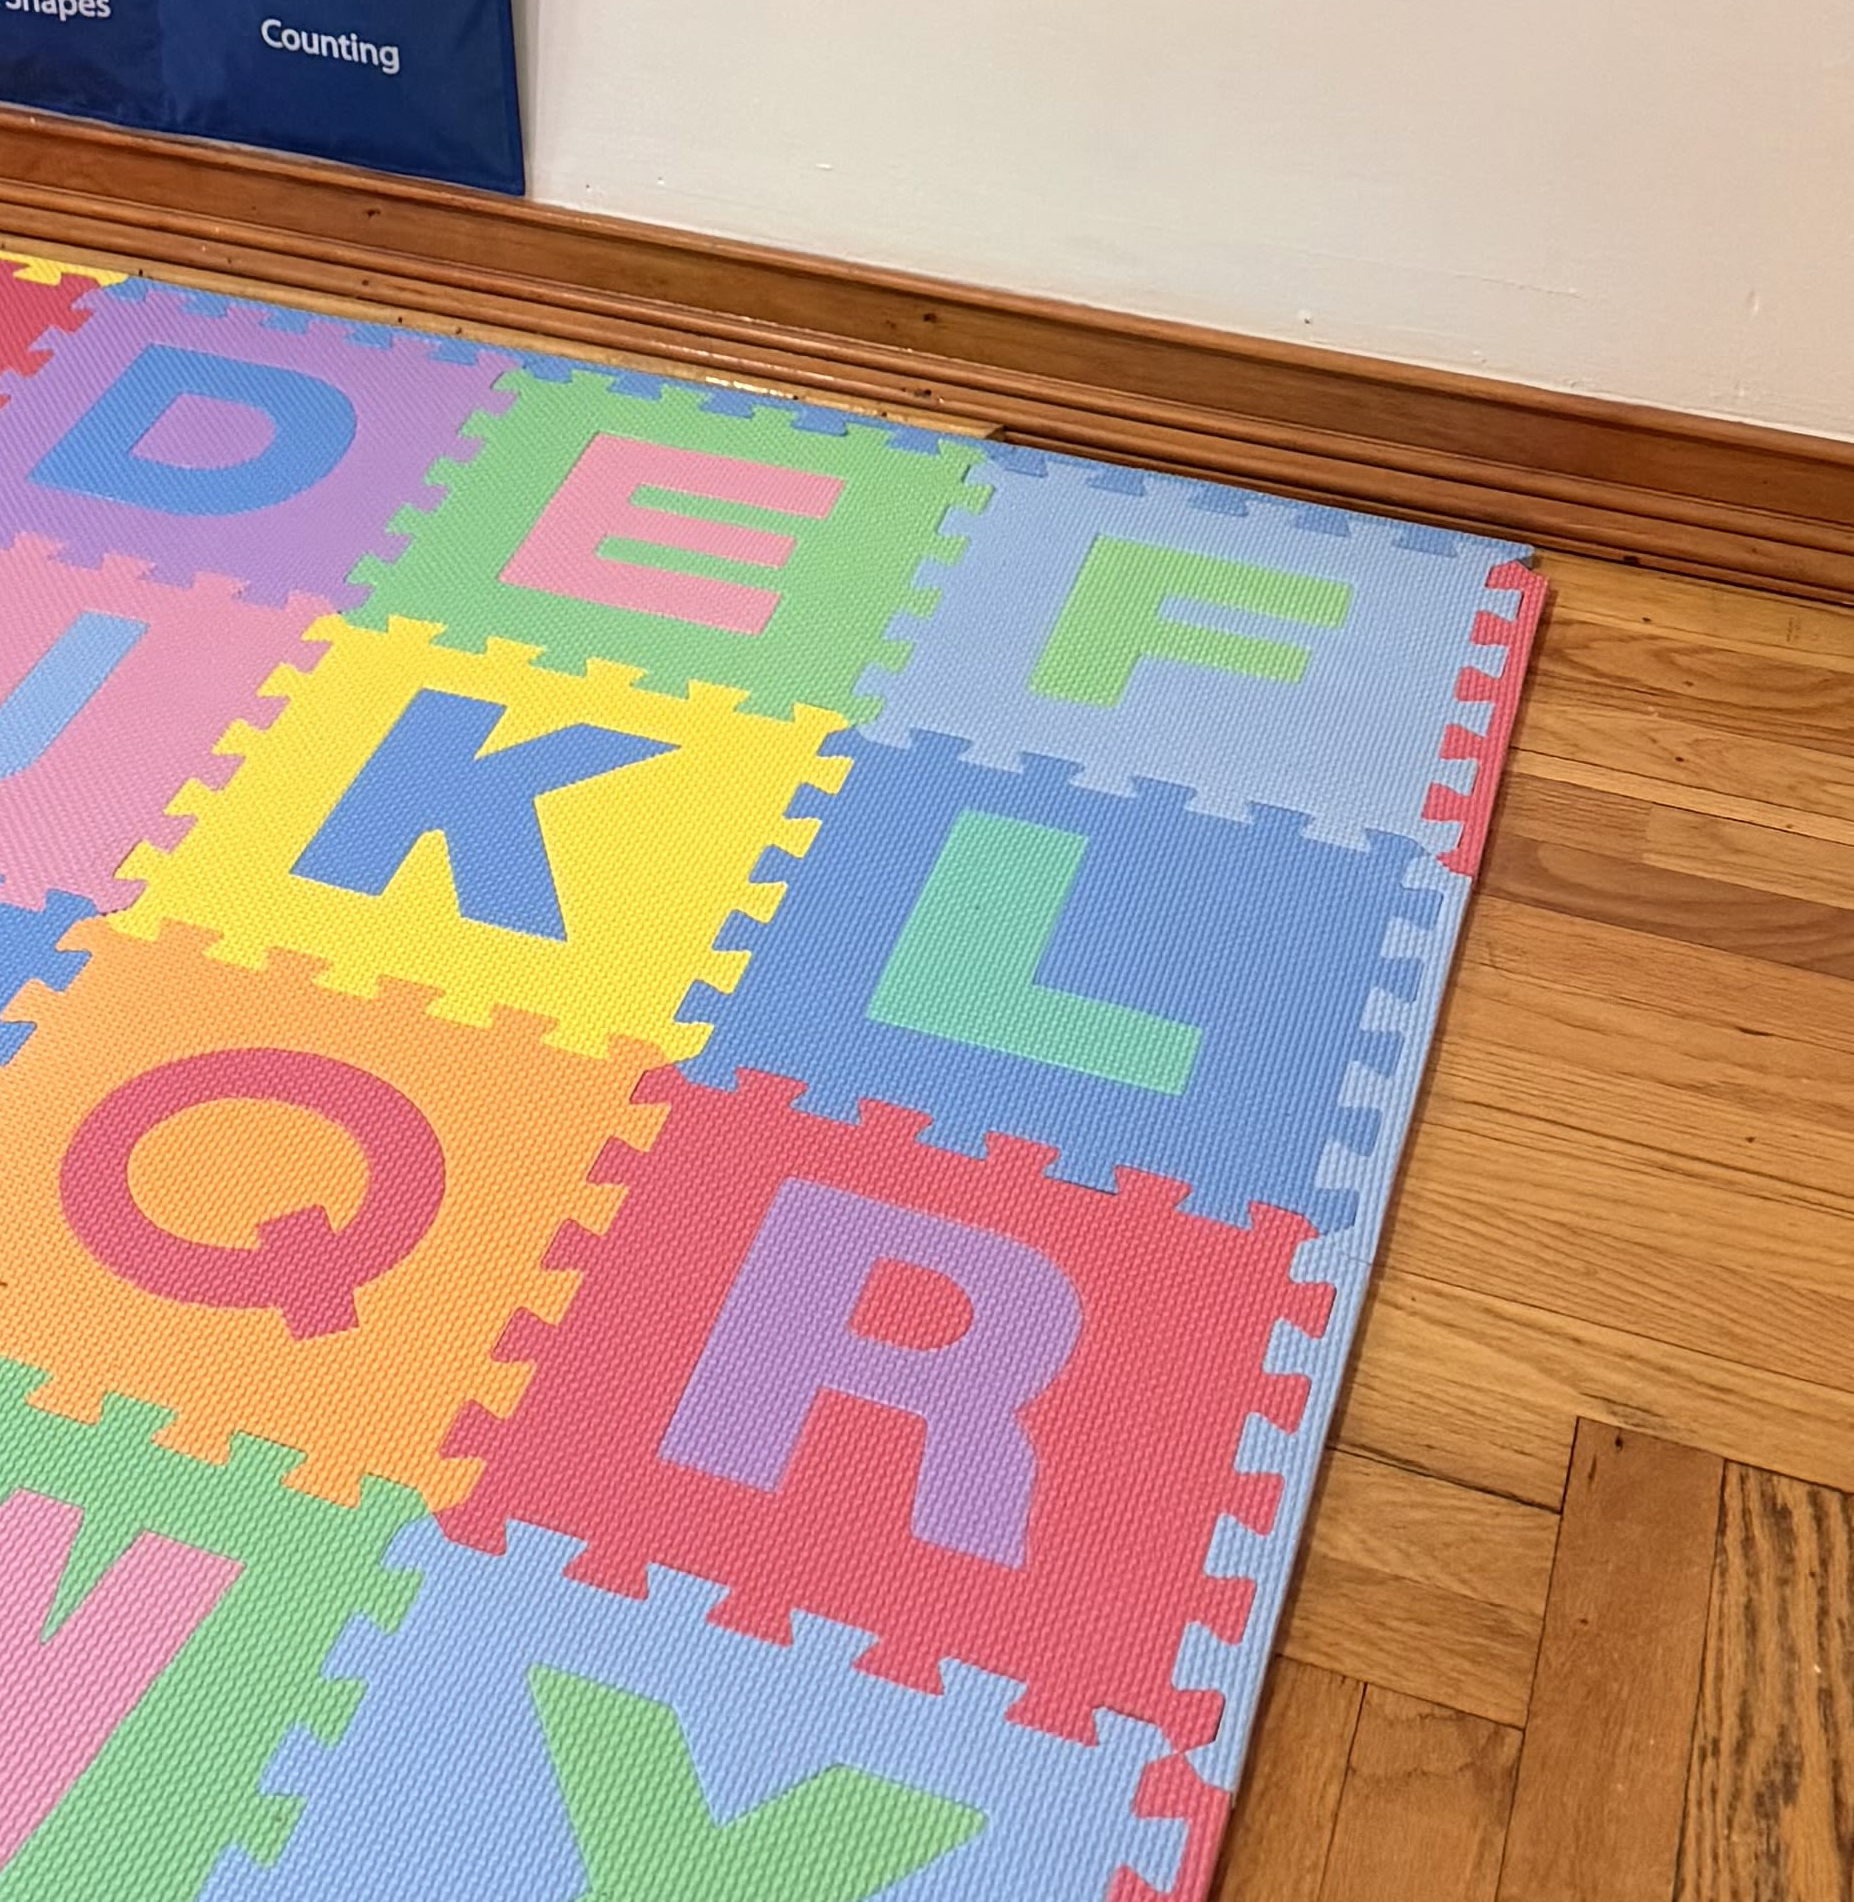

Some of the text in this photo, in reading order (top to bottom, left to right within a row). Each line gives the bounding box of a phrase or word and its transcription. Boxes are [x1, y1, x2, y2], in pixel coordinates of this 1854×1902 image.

[261, 18, 400, 74] Counting
[26, 342, 359, 517] D
[288, 686, 683, 943] K
[656, 1176, 1085, 1572] R
